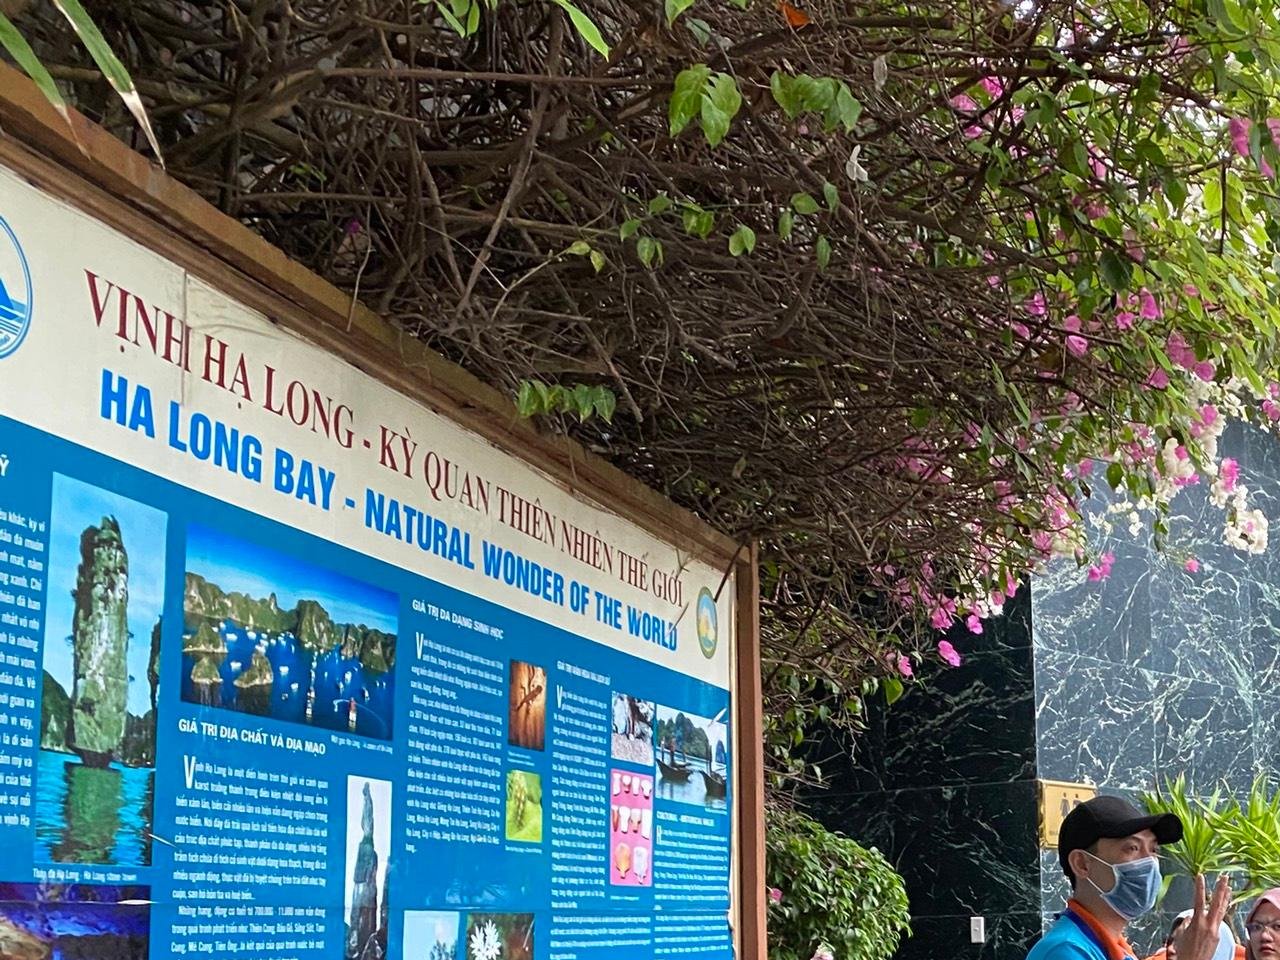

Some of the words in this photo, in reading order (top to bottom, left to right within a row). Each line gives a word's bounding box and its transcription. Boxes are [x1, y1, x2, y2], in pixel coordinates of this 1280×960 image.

[84, 269, 190, 373] VỊNH
[202, 333, 252, 410] HẠ
[263, 365, 355, 448] LONG
[379, 424, 417, 480] KỲ
[424, 450, 491, 516] QUAN
[496, 486, 556, 546] THIÊN
[561, 519, 613, 573] NHIÊN
[617, 551, 649, 593] THẾ
[652, 562, 684, 607] GIỚI
[100, 368, 155, 439] HA
[168, 401, 261, 484] LONG
[274, 447, 335, 512] BAY
[365, 488, 475, 570] NATURAL
[483, 539, 564, 607] WONDER
[570, 580, 590, 615] OF
[594, 591, 622, 630] THE
[627, 601, 678, 652] WORLD
[179, 717, 197, 734] GIÁ
[201, 722, 217, 740] TRỊ
[241, 728, 267, 745] CHẤT
[271, 734, 284, 747] VÀ
[305, 741, 326, 756] MẠO
